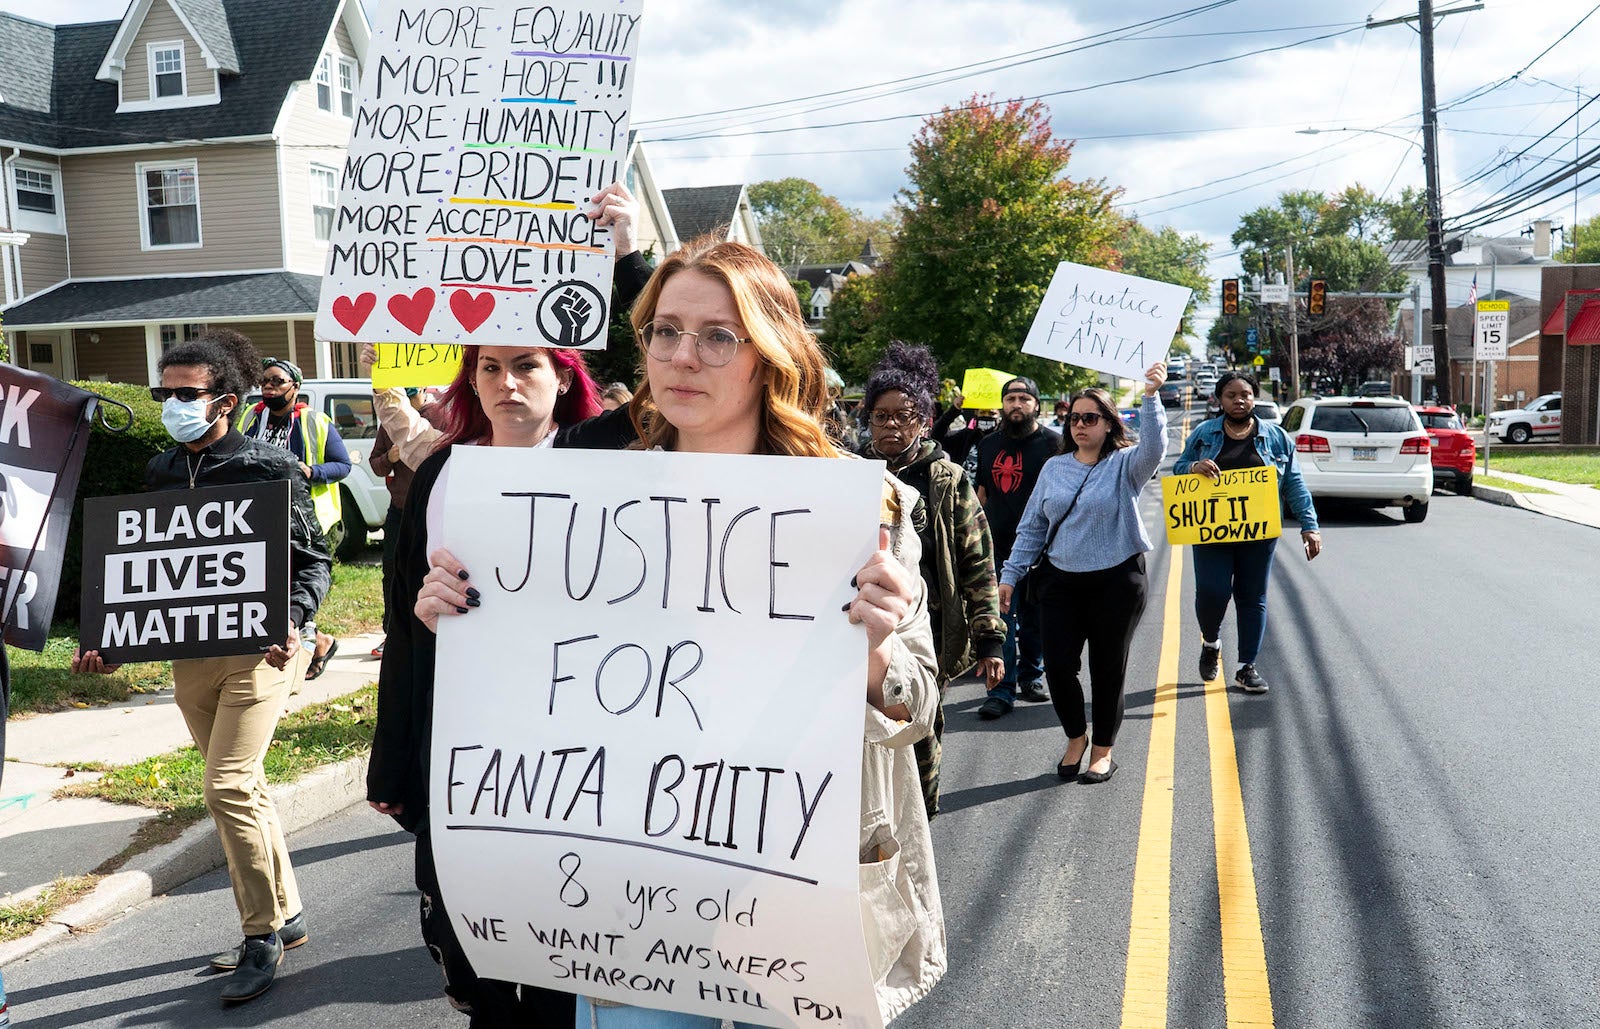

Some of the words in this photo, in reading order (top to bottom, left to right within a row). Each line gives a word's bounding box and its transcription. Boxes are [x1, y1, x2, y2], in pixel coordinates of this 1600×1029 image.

[395, 7, 494, 49] MORE
[511, 7, 641, 53] EQUALITY
[377, 55, 482, 100] MORE
[354, 104, 447, 144] MORE
[463, 107, 627, 151] HUMANITY
[341, 151, 443, 197] MORE
[337, 204, 422, 235] MORE
[426, 208, 609, 248] ACCEPTANCE
[330, 241, 418, 279] MORE
[1047, 320, 1146, 369] FANTA
[1080, 311, 1116, 336] for
[1483, 330, 1501, 344] 15
[0, 383, 42, 449] K
[1175, 478, 1200, 496] NO
[1214, 470, 1269, 487] JUSTICE
[117, 499, 254, 546] BLACK
[1169, 498, 1219, 529] SHUT
[1227, 496, 1249, 522] IT
[1200, 521, 1268, 542] DOWN!
[122, 551, 246, 596] LIVES
[495, 491, 815, 620] JUSTICE
[101, 601, 269, 649] MATTER
[549, 634, 704, 731] FOR
[447, 743, 605, 827] FANTA
[644, 754, 833, 861] BILITY
[558, 852, 590, 908] 8
[625, 878, 677, 930] yrs
[696, 891, 758, 928] old
[462, 914, 507, 942] WE
[528, 921, 625, 957] WANT
[645, 938, 809, 983] ANSWERS
[549, 954, 675, 995] SHARON
[699, 980, 768, 1011] HILL
